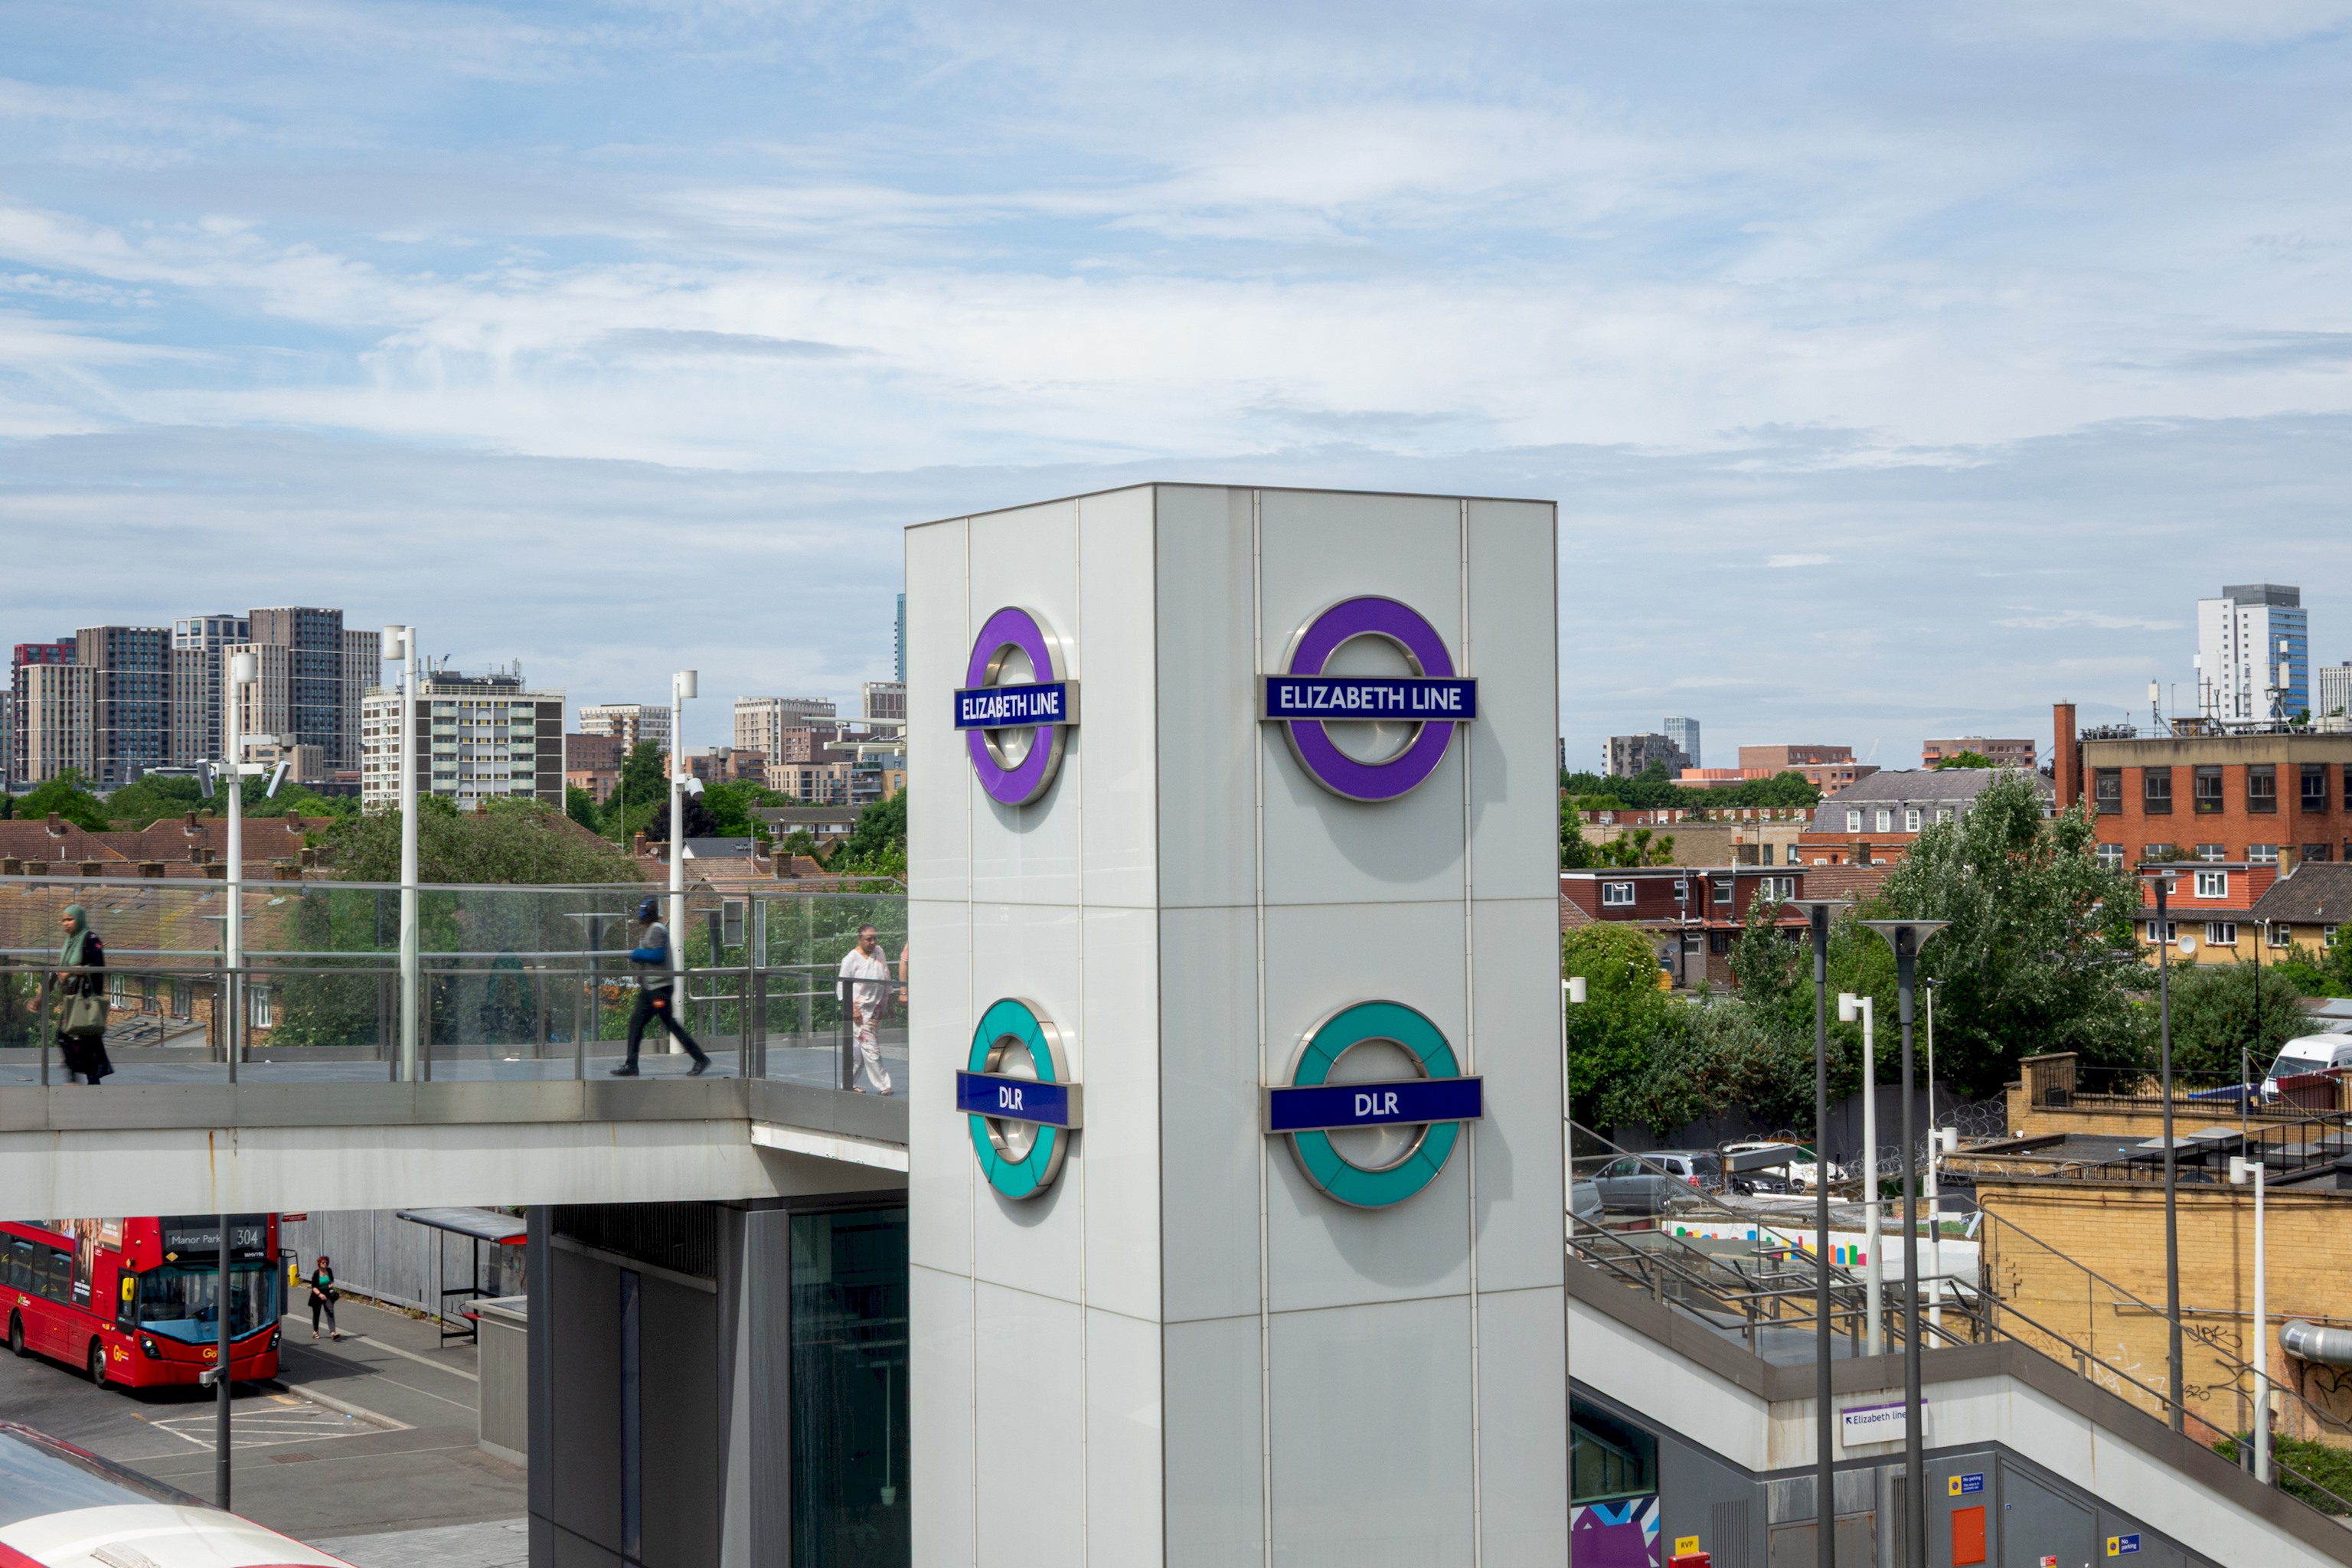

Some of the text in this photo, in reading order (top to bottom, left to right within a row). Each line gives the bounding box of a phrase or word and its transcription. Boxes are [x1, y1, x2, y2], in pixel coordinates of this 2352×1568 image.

[963, 692, 1059, 720] ELIZABETH LINE
[1280, 685, 1462, 710] ELIZABETH LINE
[999, 1086, 1023, 1111] DLR
[1355, 1092, 1400, 1116] DLR
[172, 1234, 221, 1245] Manor Park
[237, 1229, 258, 1245] 304
[1854, 1411, 1906, 1424] Elizabeth line
[1681, 1540, 1694, 1549] RVP
